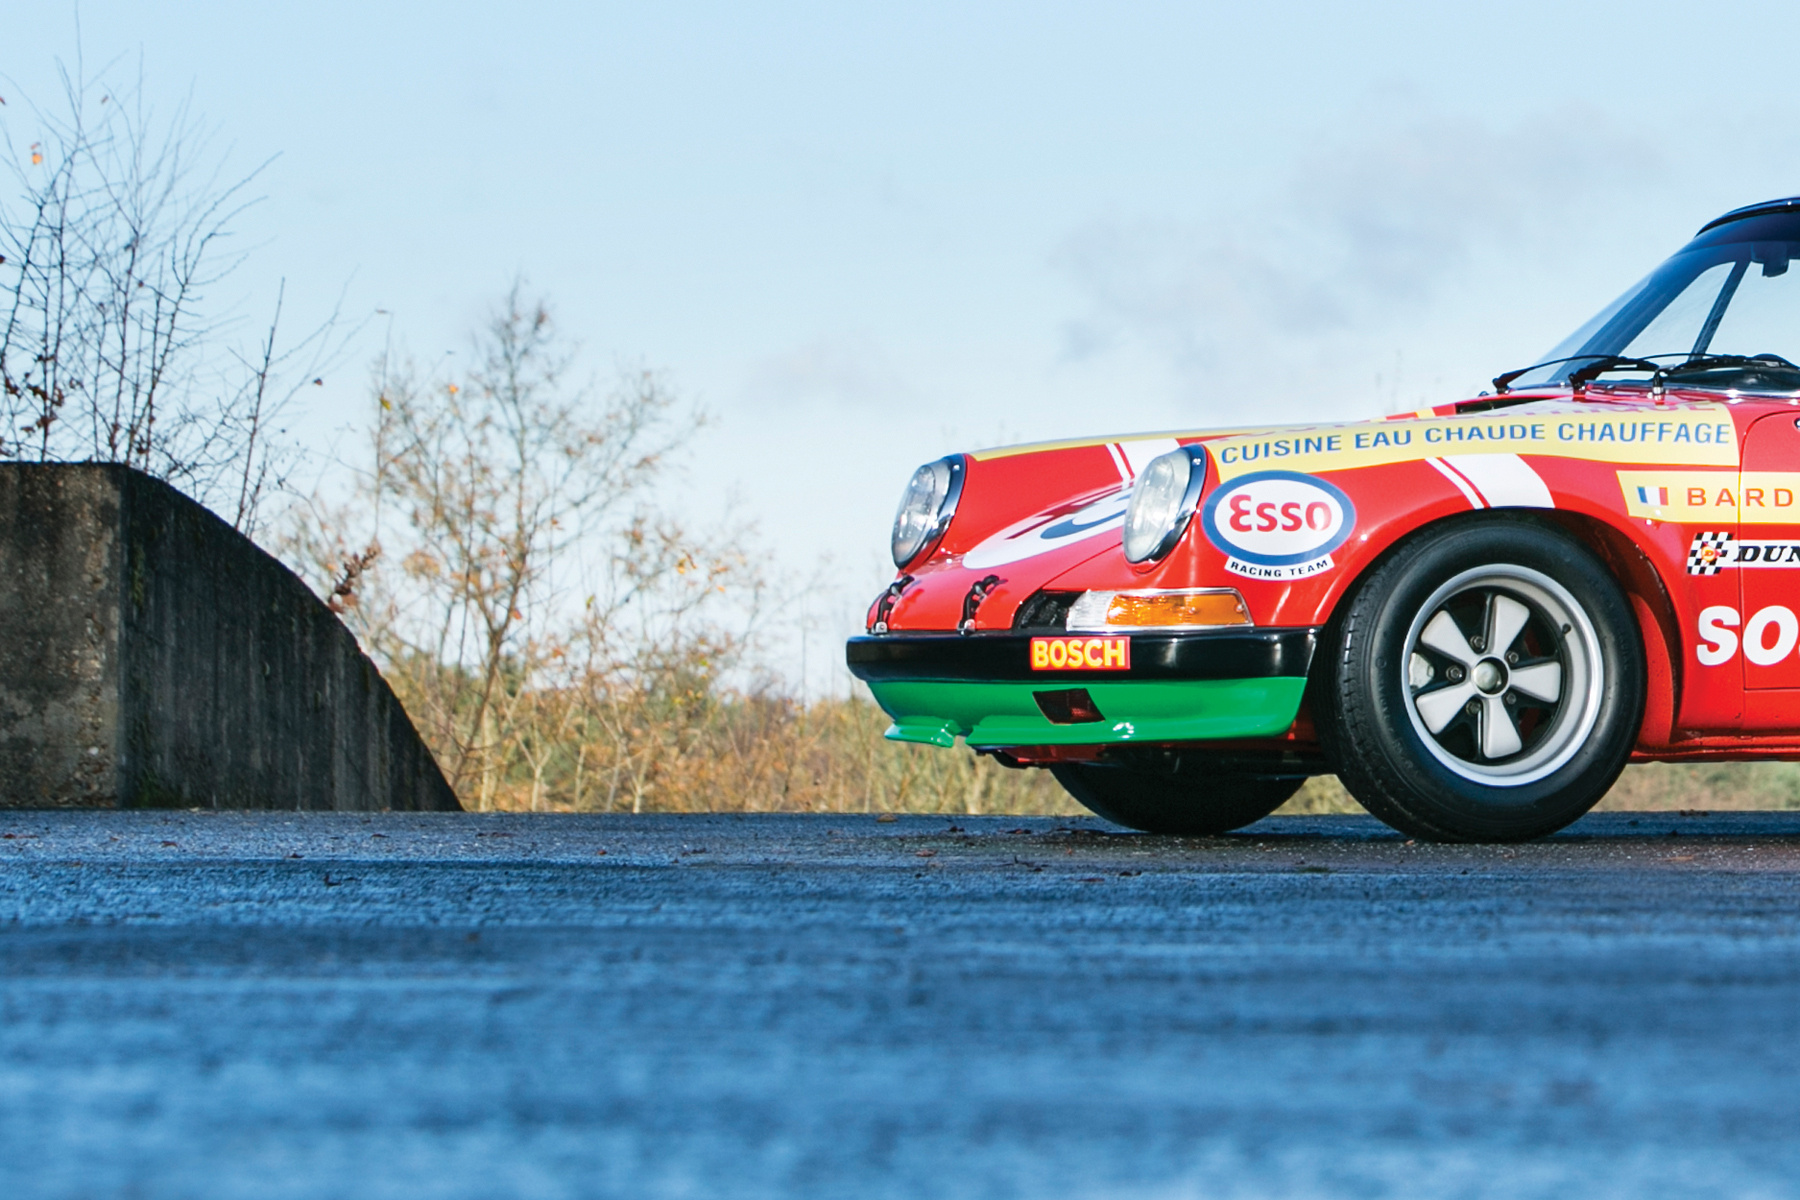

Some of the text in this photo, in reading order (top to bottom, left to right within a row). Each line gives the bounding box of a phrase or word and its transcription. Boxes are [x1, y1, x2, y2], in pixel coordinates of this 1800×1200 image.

[1221, 422, 1731, 464] CUISINE EAU CHAUDE CHAUFFAGE
[1230, 559, 1328, 578] RACING TEAM
[1033, 639, 1126, 668] BOSCH
